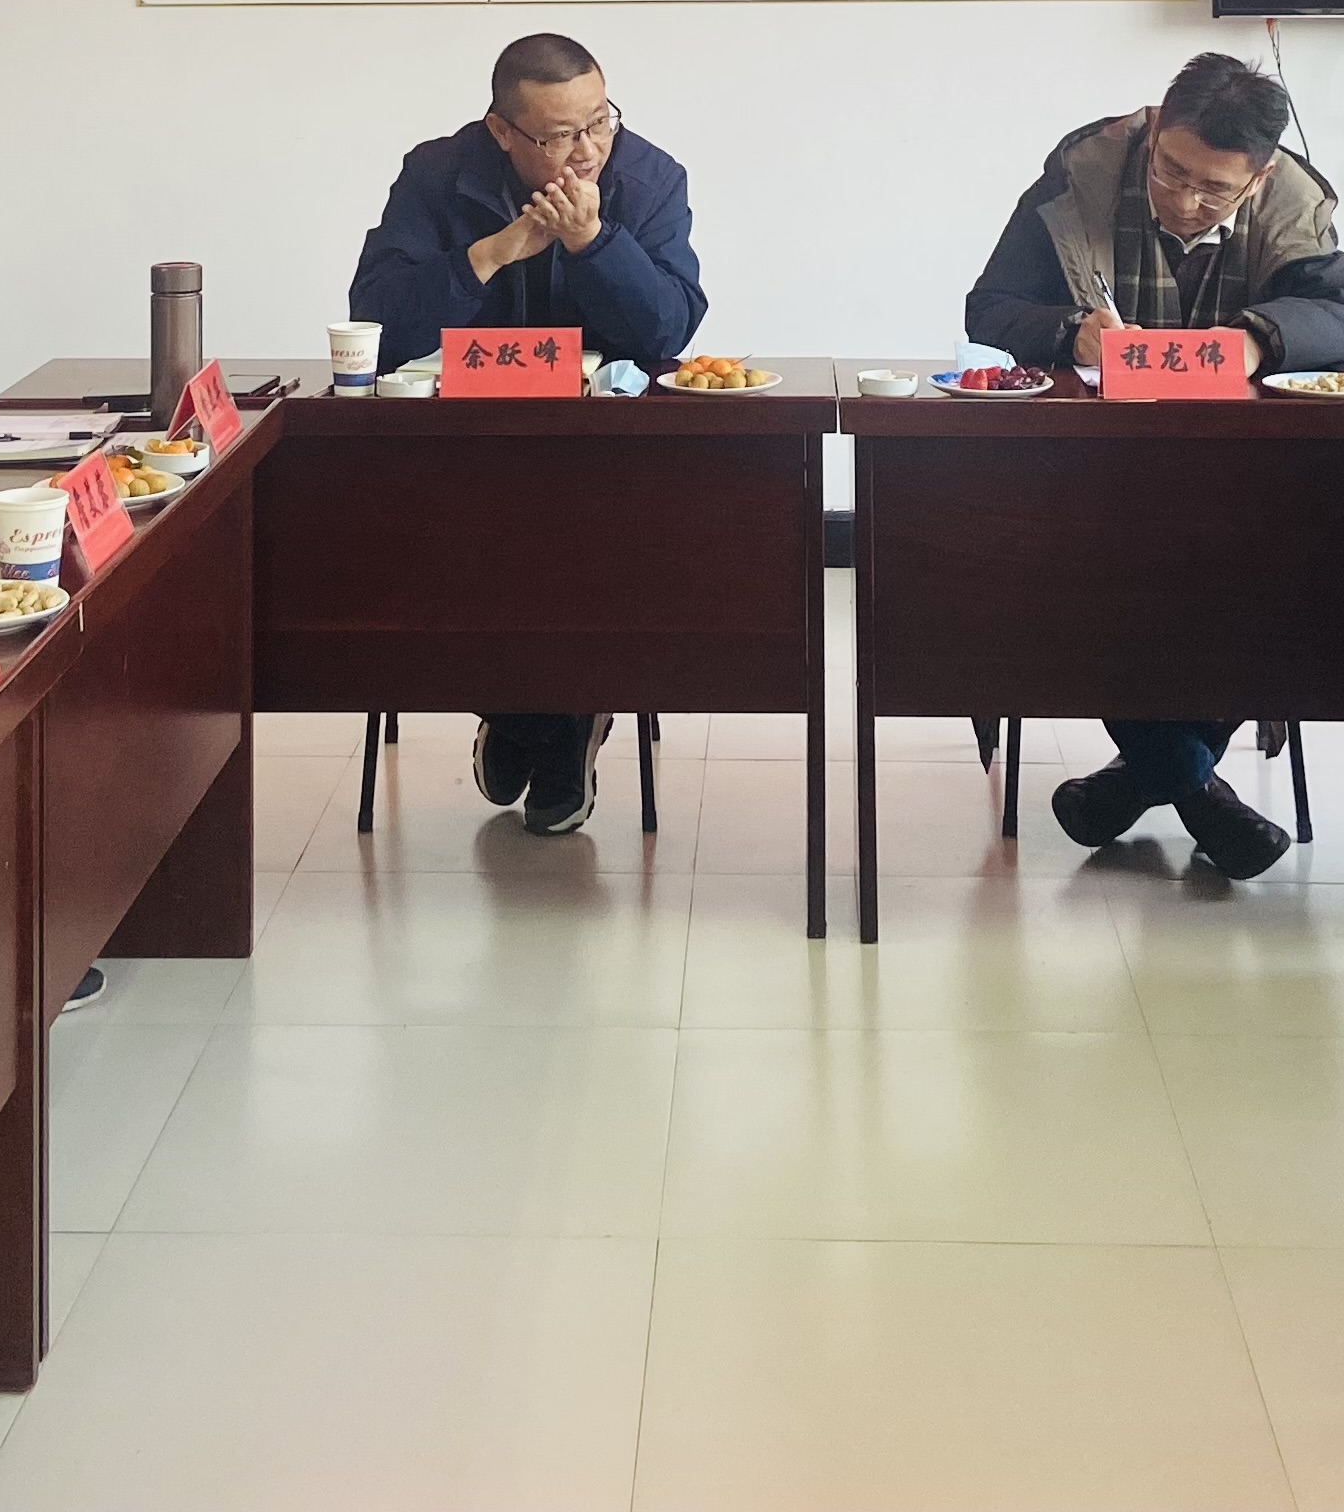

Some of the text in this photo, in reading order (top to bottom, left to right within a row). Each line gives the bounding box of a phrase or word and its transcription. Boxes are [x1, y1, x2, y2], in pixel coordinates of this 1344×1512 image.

[462, 337, 562, 372] 余跃峰
[1120, 341, 1225, 374] 程龙伟
